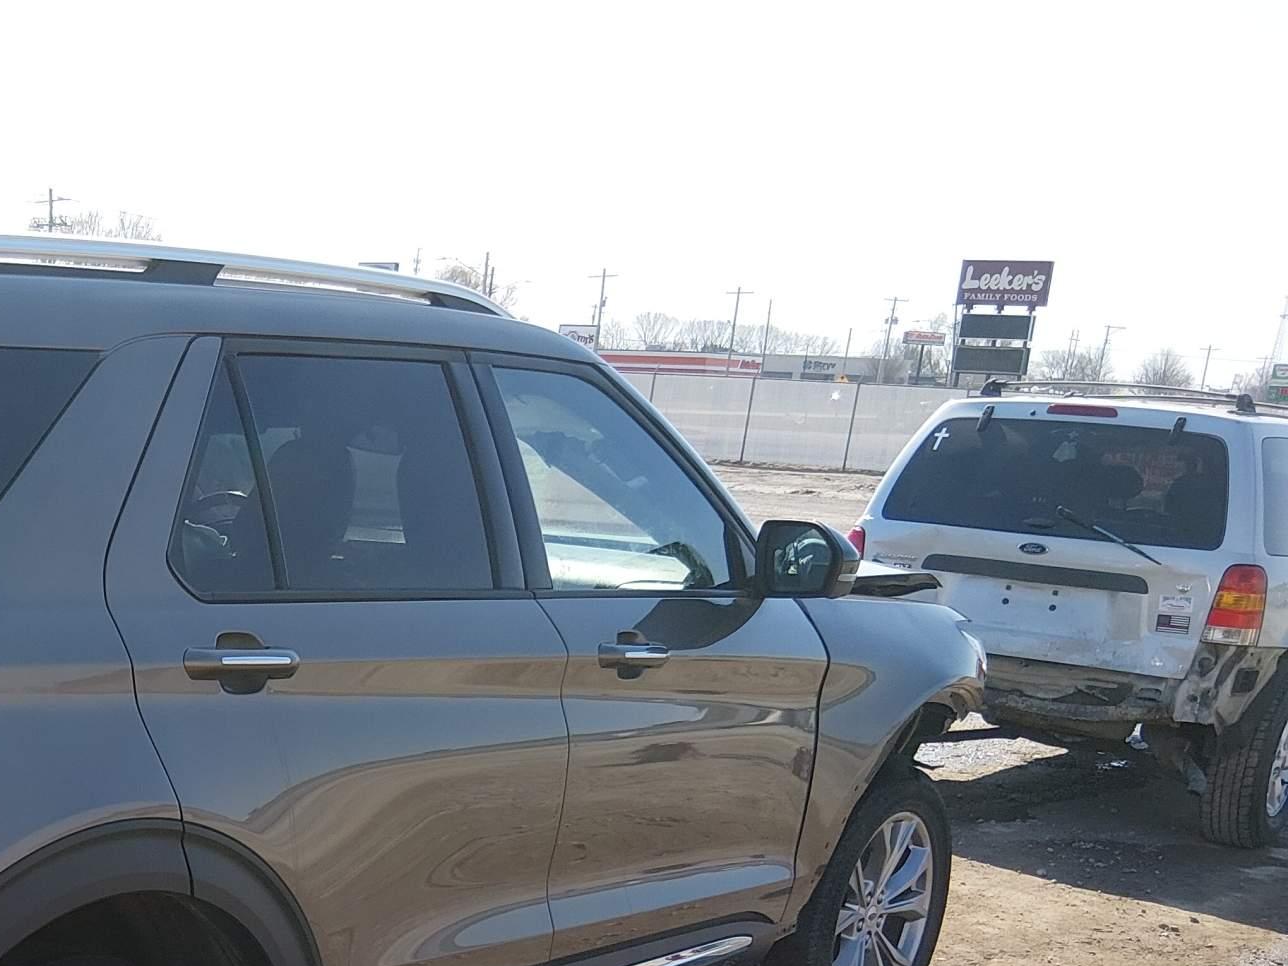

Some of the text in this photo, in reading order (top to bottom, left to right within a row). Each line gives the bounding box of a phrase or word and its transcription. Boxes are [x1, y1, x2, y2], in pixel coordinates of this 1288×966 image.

[961, 265, 1047, 291] Leeker's
[963, 292, 1039, 302] FAMILY FOODS
